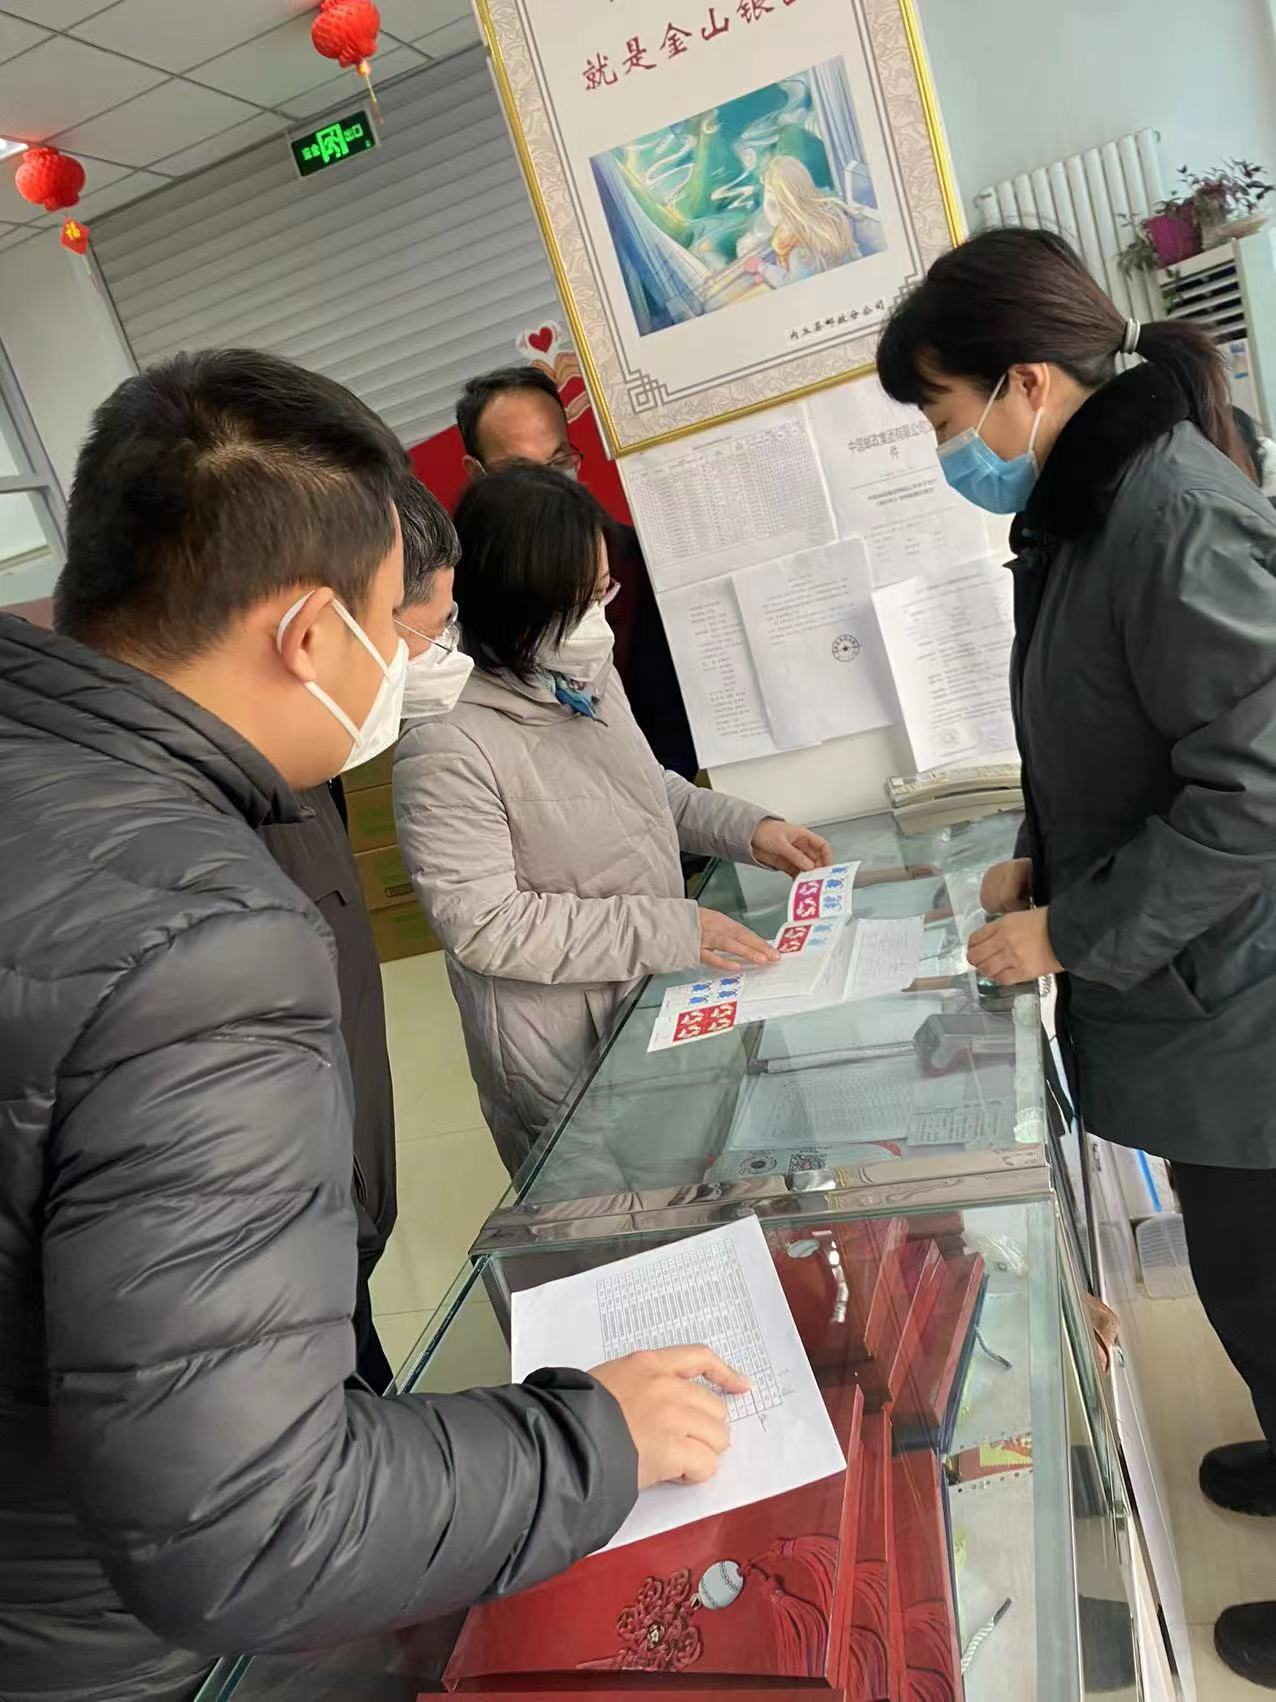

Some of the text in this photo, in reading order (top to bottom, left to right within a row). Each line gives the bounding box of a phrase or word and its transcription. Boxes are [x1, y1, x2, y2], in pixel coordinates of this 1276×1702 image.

[582, 0, 797, 90] 就是金山银
